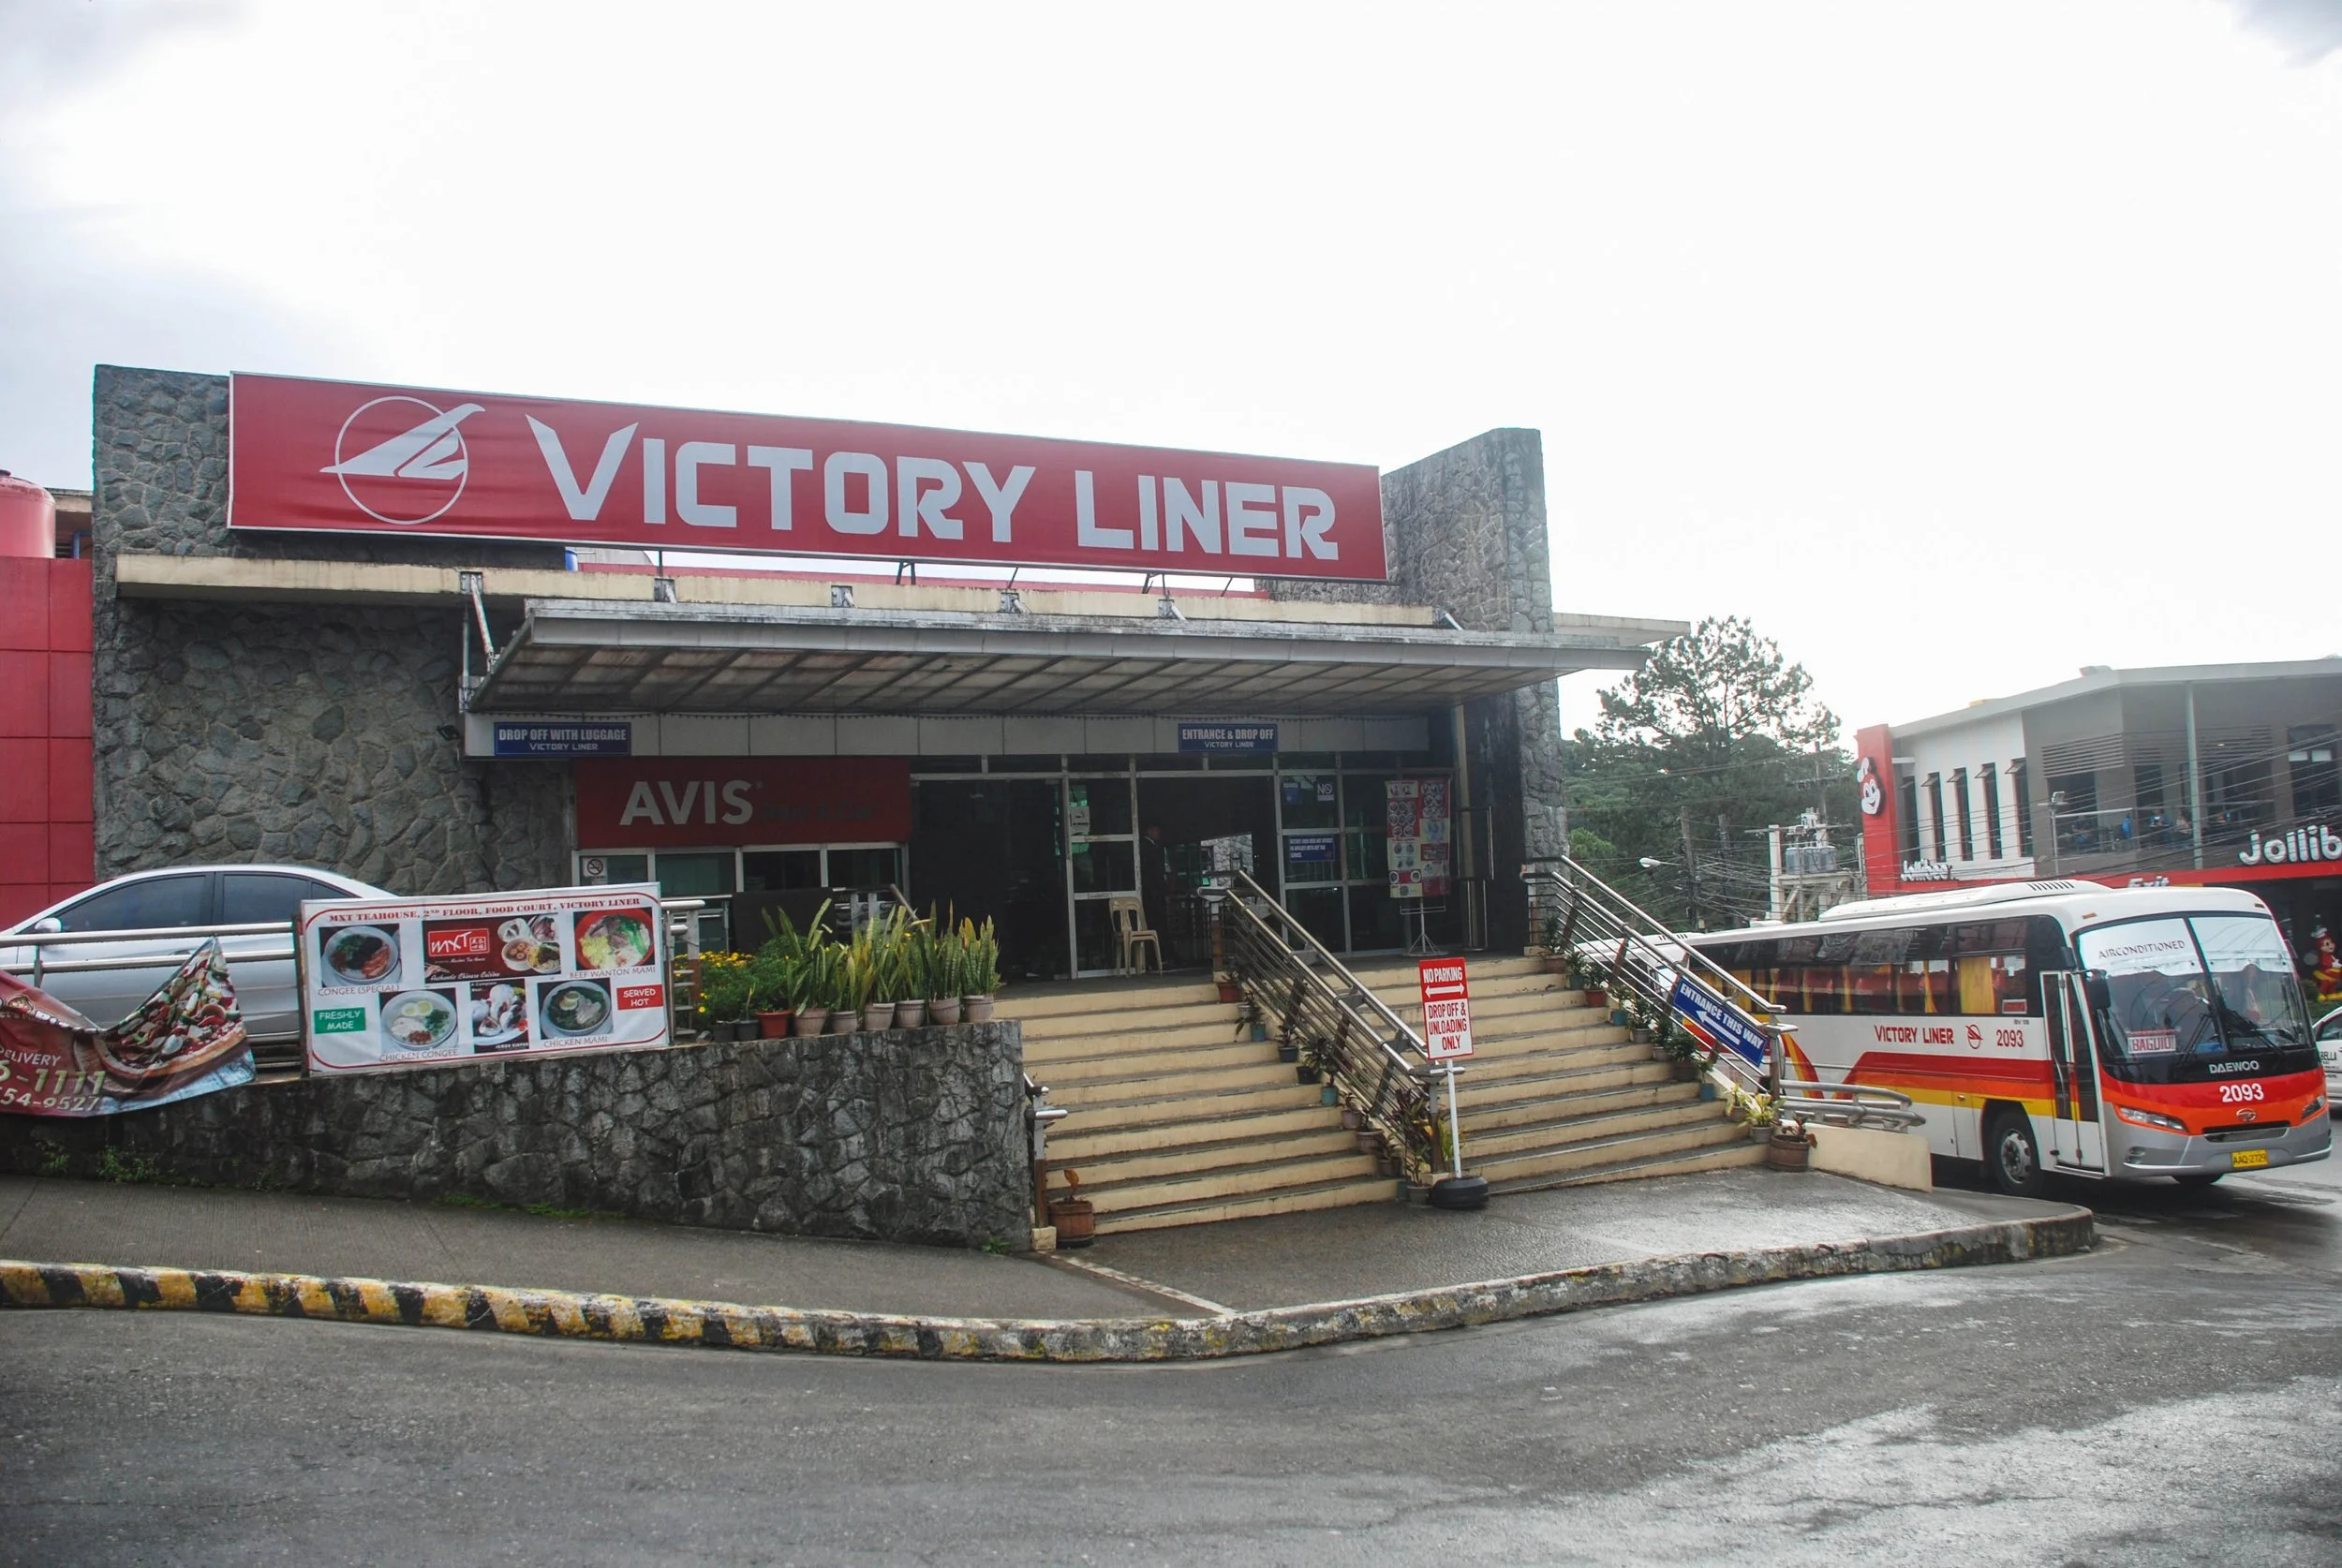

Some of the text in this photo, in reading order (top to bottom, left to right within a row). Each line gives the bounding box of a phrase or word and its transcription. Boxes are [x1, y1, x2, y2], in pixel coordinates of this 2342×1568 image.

[526, 414, 1339, 560] VICTORY LINER
[498, 729, 627, 741] DROP OFF WITH LUGGAGE
[1182, 729, 1274, 740] ENTRANCE & DROP OFF
[619, 779, 753, 826] AVIS
[561, 899, 605, 909] VICTORY
[609, 897, 641, 906] LINER
[2098, 940, 2185, 959] AIRCONDITIONED
[591, 969, 630, 978] WANTON
[1422, 967, 1463, 984] NO PARKING
[318, 985, 400, 997] CONGEE (SPECIAL)
[624, 988, 656, 998] SERVED
[631, 998, 650, 1007] HOT
[319, 1011, 361, 1020] FRESHLY
[1428, 1002, 1466, 1019] DROP OFF &
[1680, 984, 1763, 1049] ENTRANCE THIS WAY
[327, 1021, 354, 1030] MADE
[1429, 1018, 1467, 1035] UNLOADING
[543, 1036, 608, 1048] CHICKEN MAMI
[1874, 1025, 2023, 1047] VICTORY LINER 2093
[1442, 1035, 1461, 1051] ONLY
[2132, 1038, 2171, 1051] BAGUIO
[379, 1049, 458, 1062] CHICKEN CONGEE
[2209, 1060, 2260, 1073] DAEWOO
[2219, 1083, 2264, 1103] 2093
